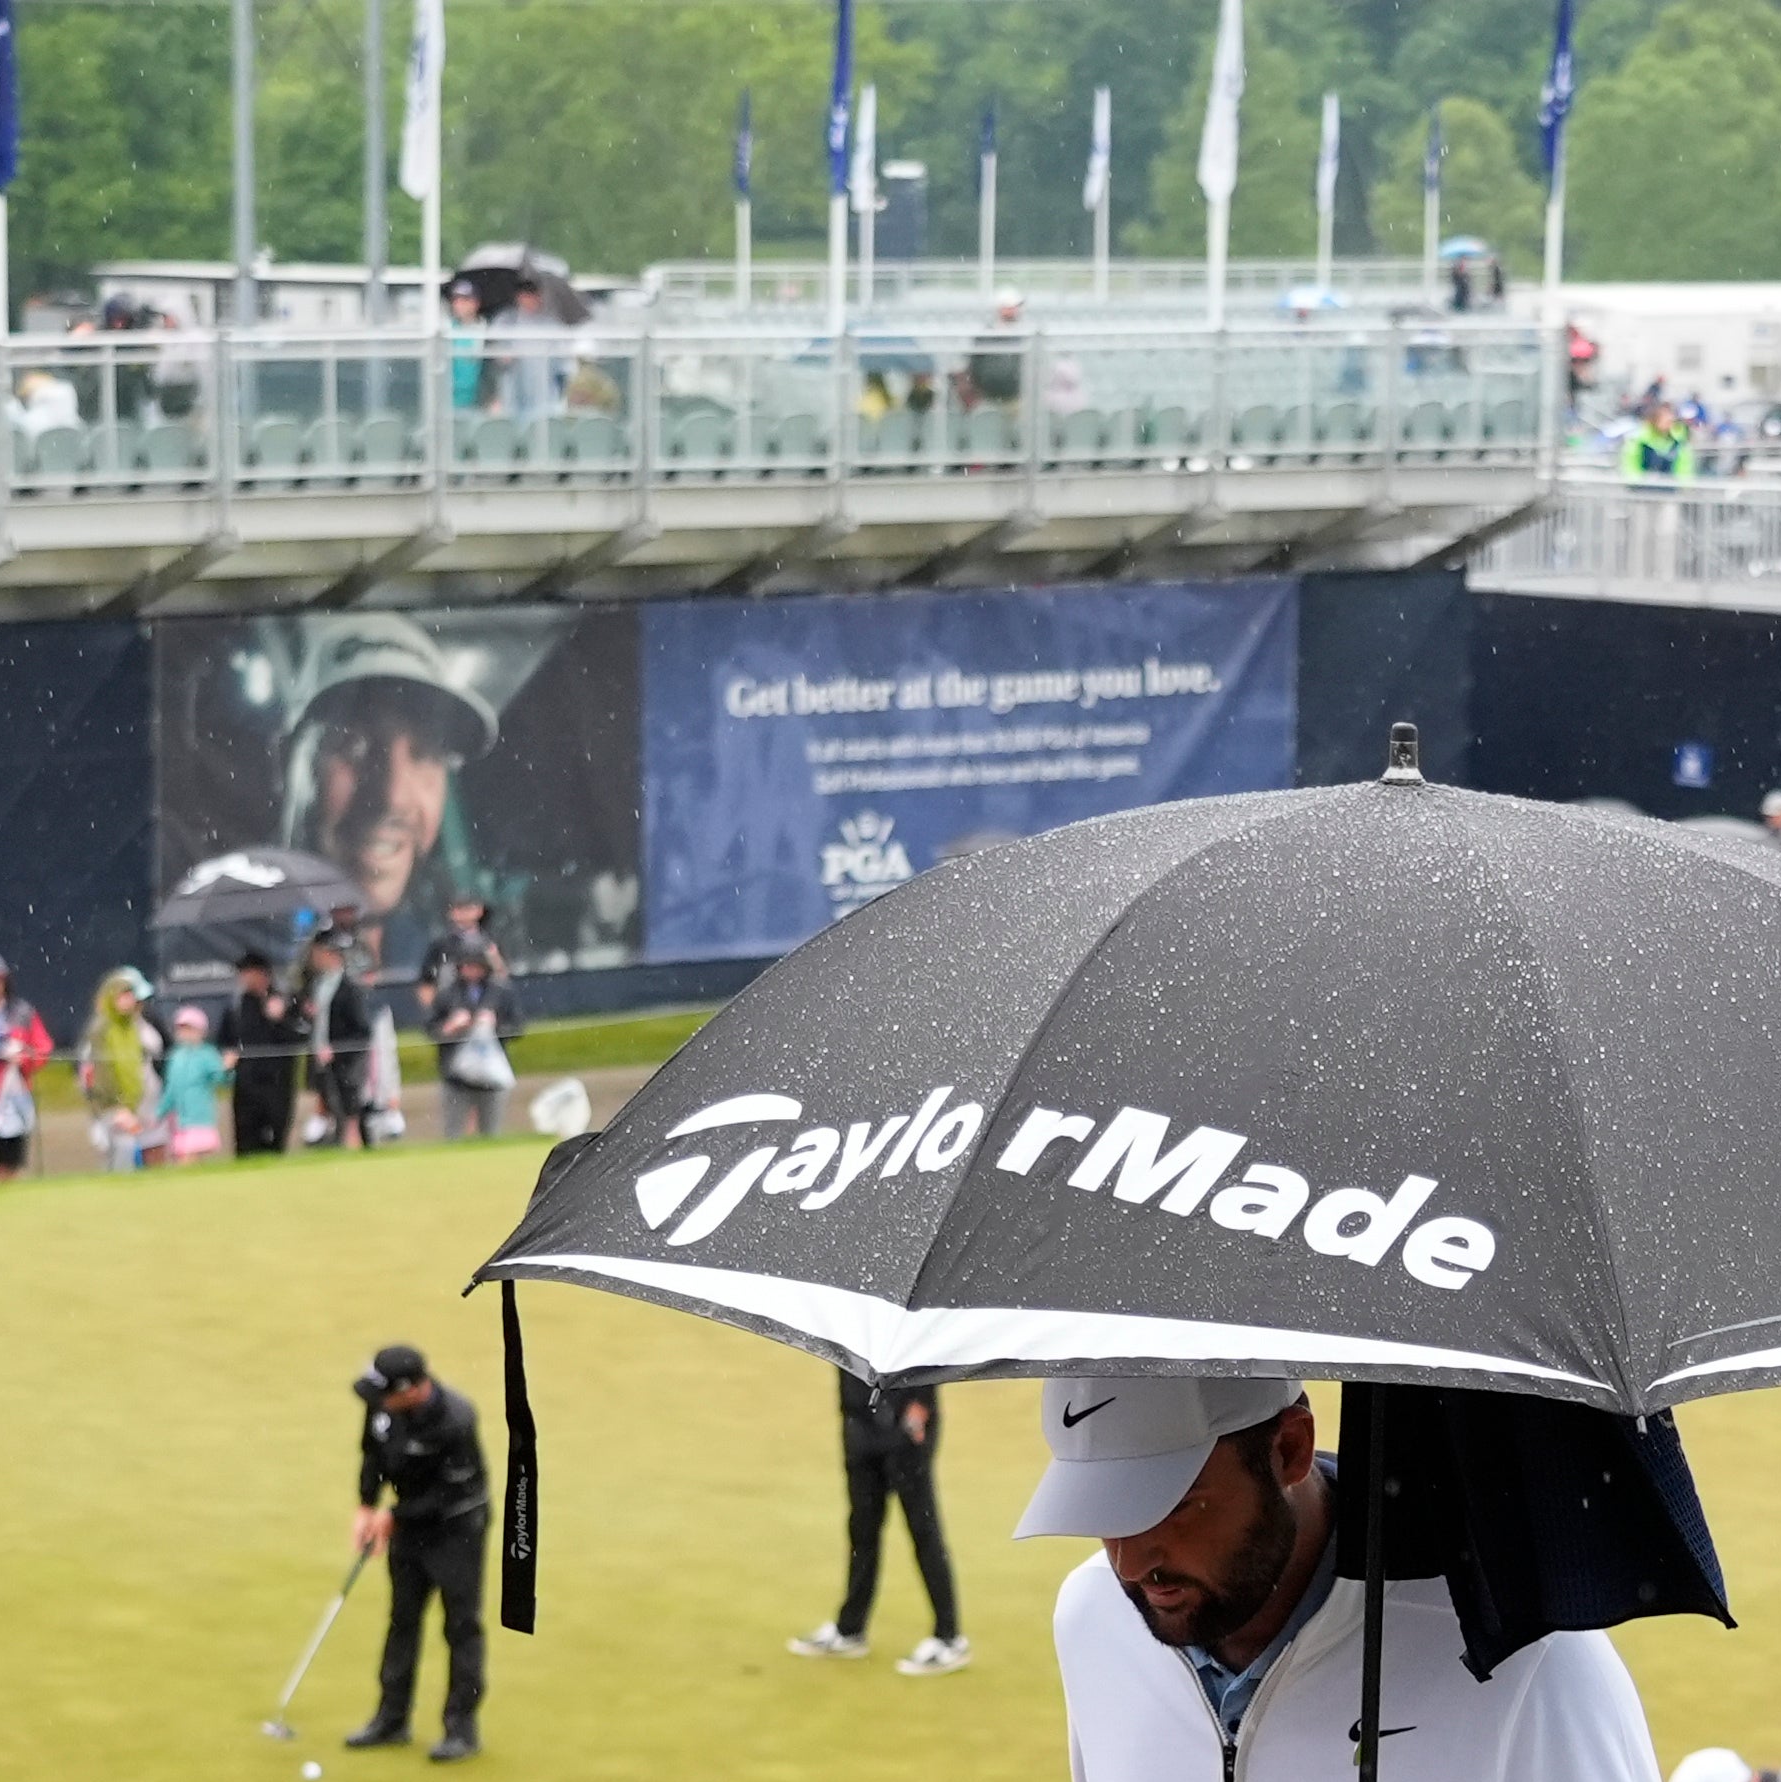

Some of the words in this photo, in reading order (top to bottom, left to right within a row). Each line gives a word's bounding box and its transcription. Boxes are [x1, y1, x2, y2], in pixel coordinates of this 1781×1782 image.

[724, 675, 789, 718] Get
[935, 666, 987, 709] the
[1080, 666, 1143, 709] you
[820, 841, 914, 885] PGA
